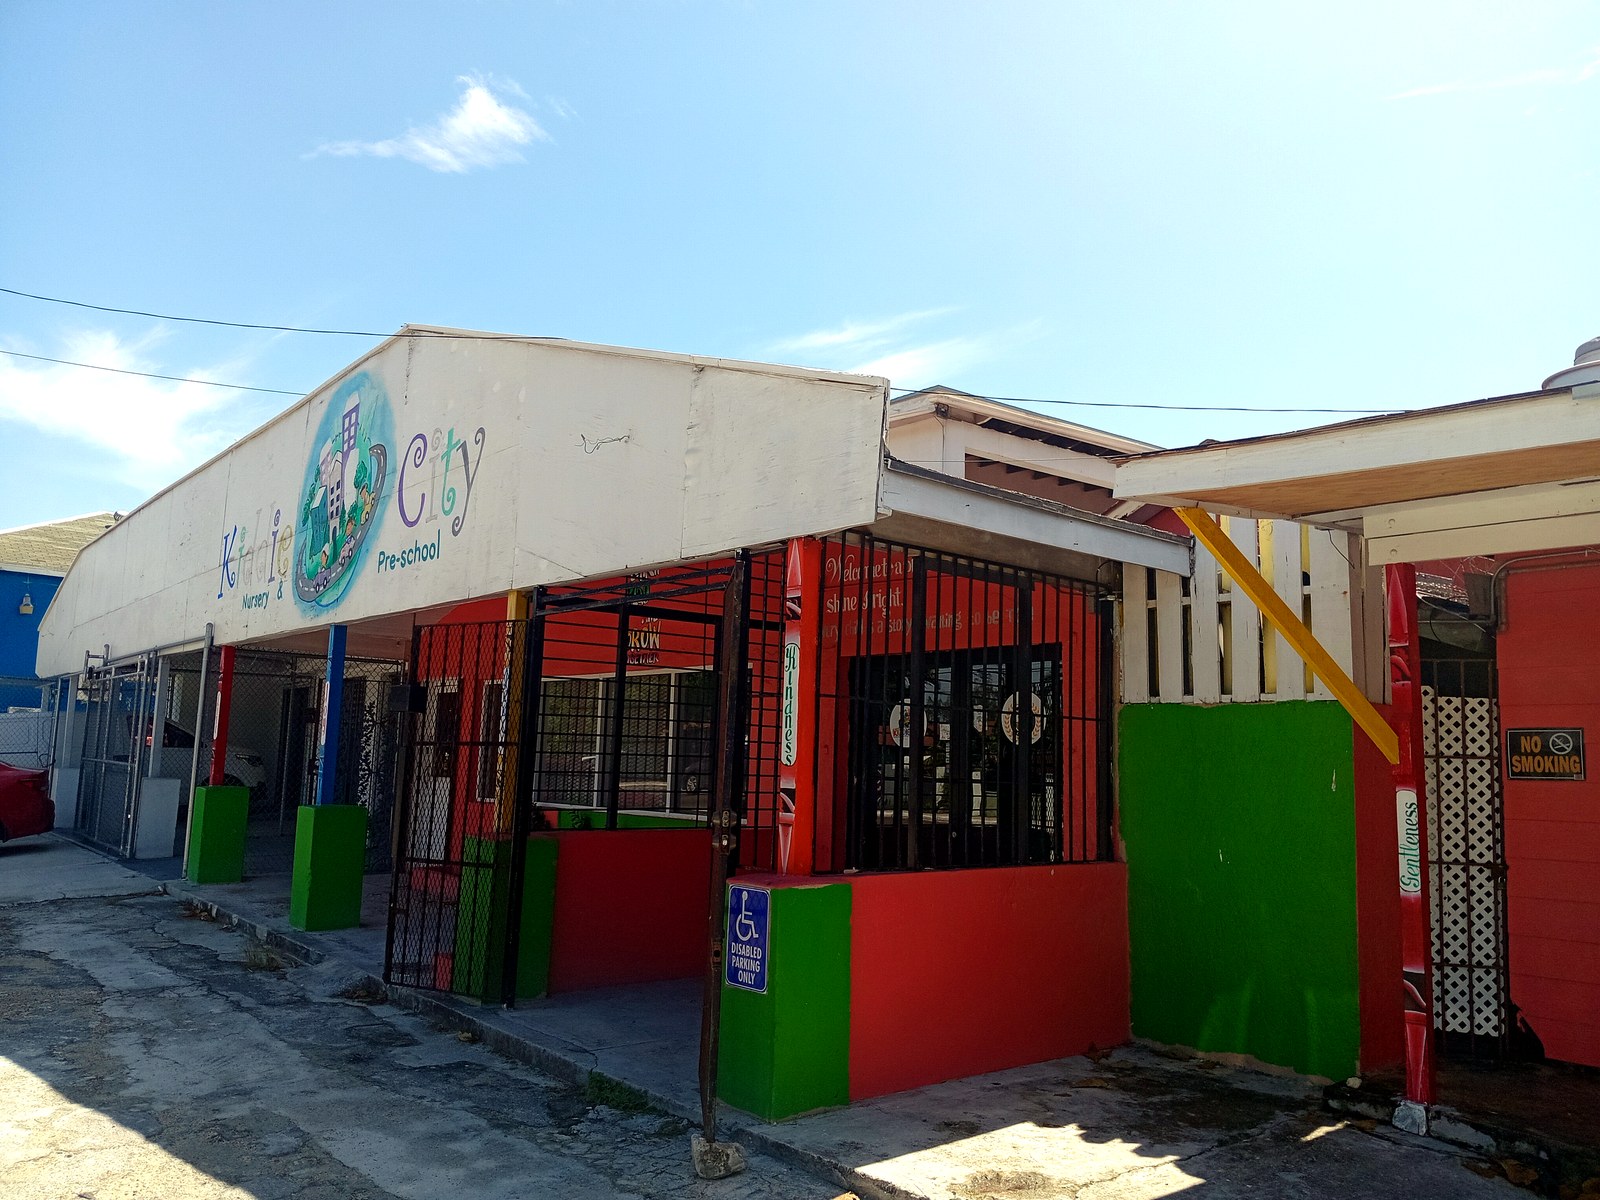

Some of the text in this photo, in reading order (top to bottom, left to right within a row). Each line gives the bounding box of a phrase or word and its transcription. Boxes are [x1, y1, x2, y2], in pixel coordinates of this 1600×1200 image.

[217, 426, 486, 600] Kiddie City
[377, 529, 441, 573] Pre-school
[242, 582, 283, 610] Nursery &
[826, 593, 858, 613] shne
[888, 618, 913, 637] stoy
[1520, 735, 1542, 753] NO
[1511, 755, 1581, 774] SMOKING
[1398, 802, 1420, 888] Gentleness
[731, 941, 762, 959] DISABLED
[731, 955, 760, 972] PARKING
[737, 971, 756, 985] ONLY
